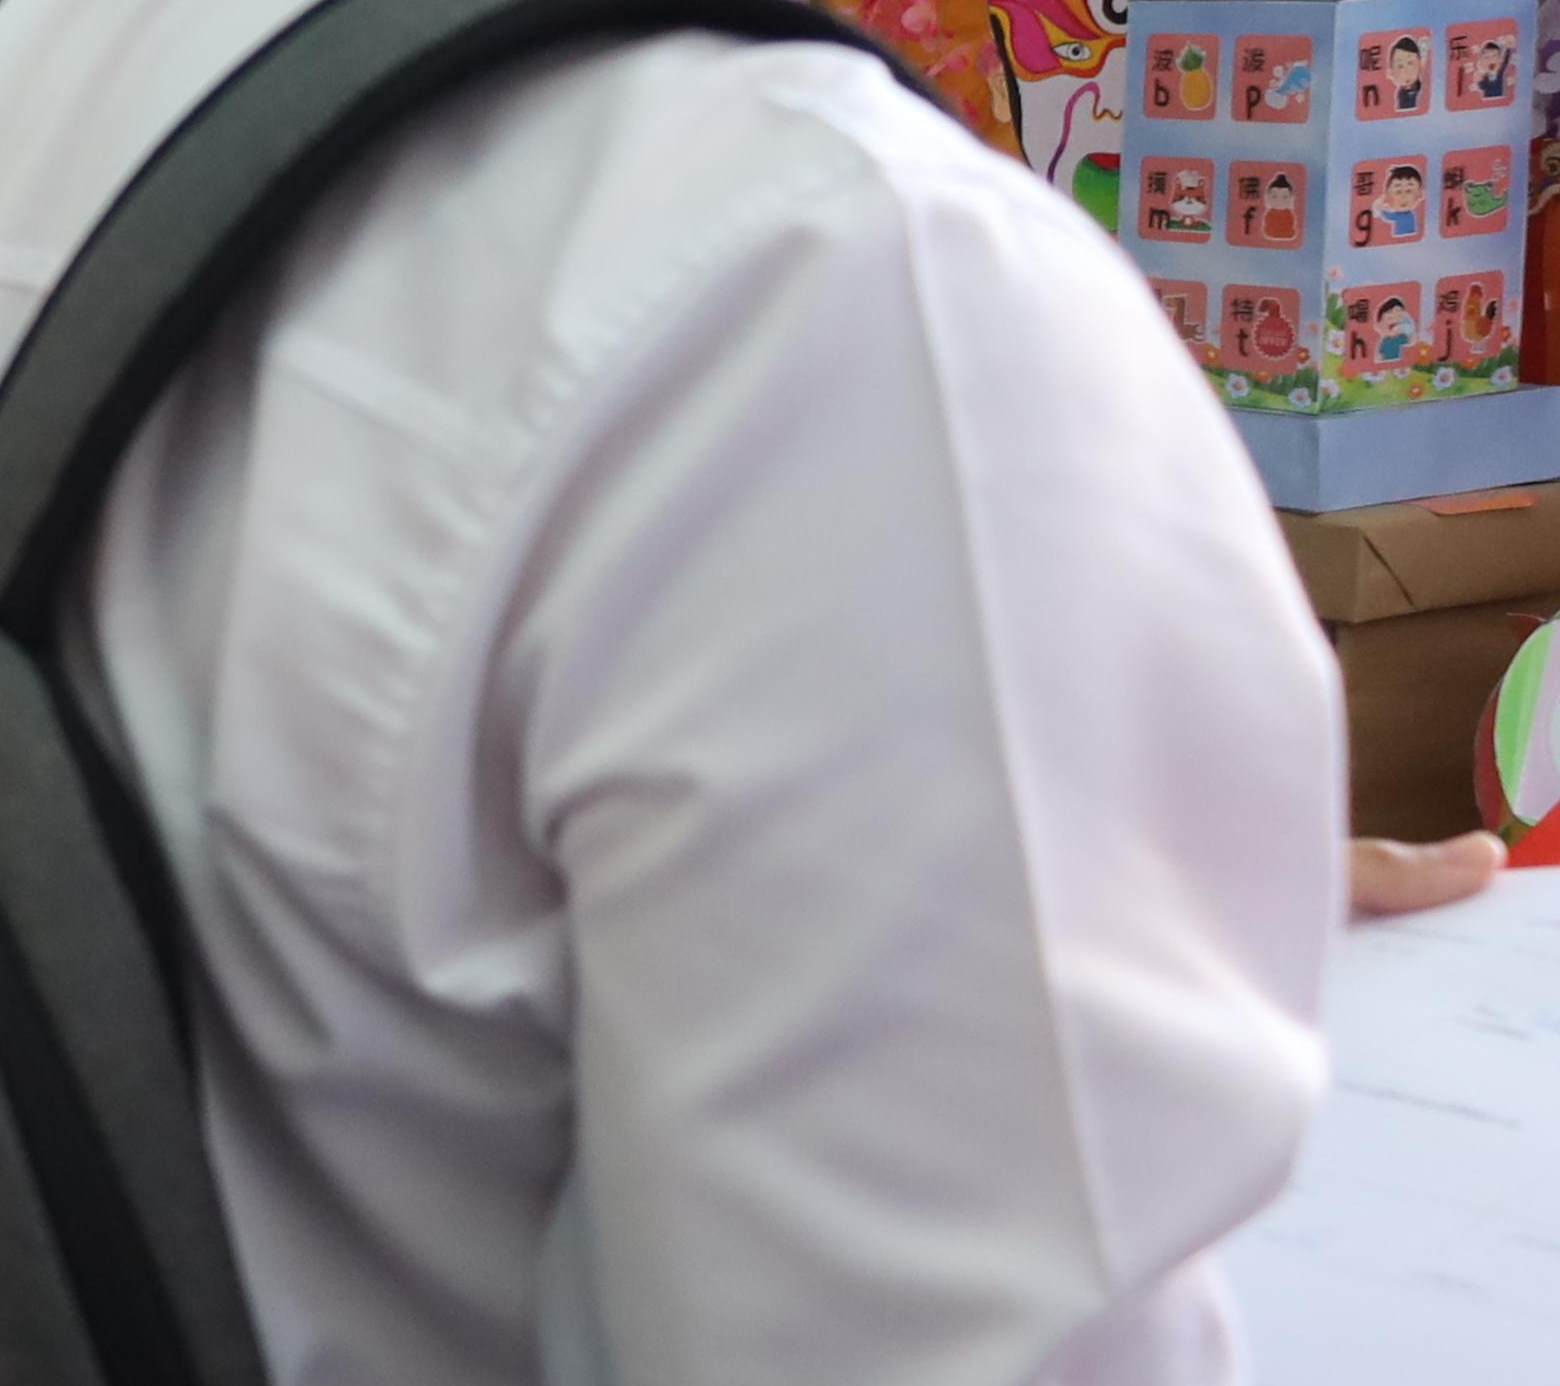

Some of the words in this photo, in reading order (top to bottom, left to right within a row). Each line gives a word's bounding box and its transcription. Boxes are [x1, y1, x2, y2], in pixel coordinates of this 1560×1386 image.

[1154, 78, 1170, 106] b
[1245, 86, 1261, 120] p
[1363, 84, 1380, 107] n
[1148, 207, 1170, 230] m
[1242, 206, 1257, 235] f
[1445, 197, 1462, 227] k
[1354, 209, 1373, 247] g
[1236, 327, 1249, 357] t
[1350, 330, 1366, 360] h
[1437, 319, 1454, 362] j
